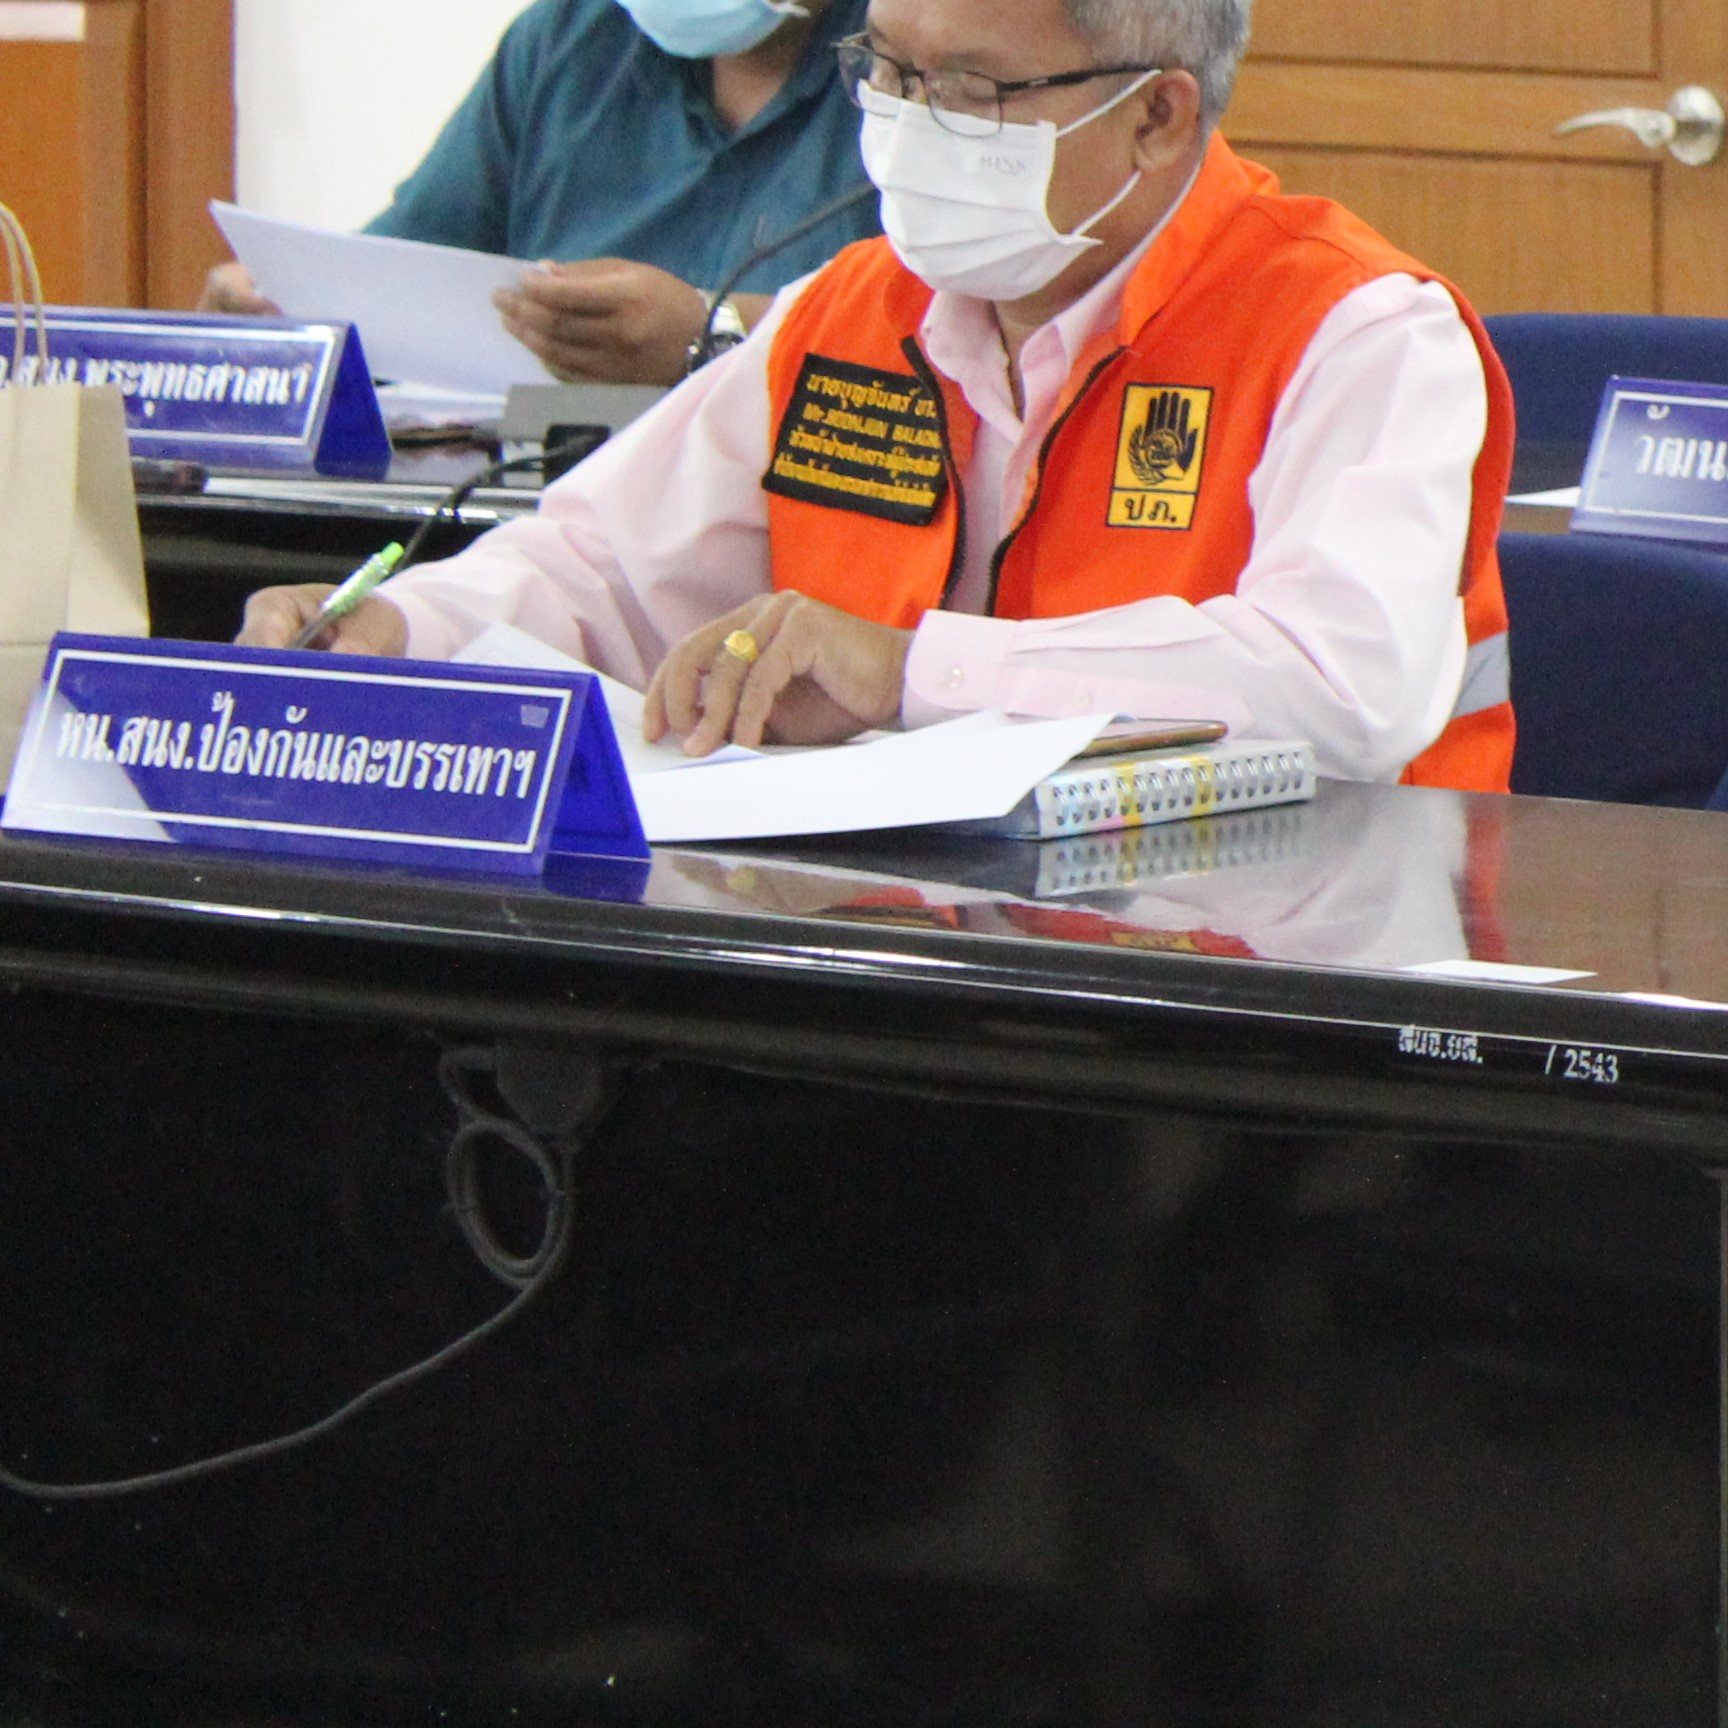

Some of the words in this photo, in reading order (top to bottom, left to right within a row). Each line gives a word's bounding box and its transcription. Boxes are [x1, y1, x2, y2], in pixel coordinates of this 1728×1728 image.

[1124, 494, 1177, 523] ปภ.
[55, 691, 538, 800] หน.สนง.ป้องกันและบรรเทาฯ
